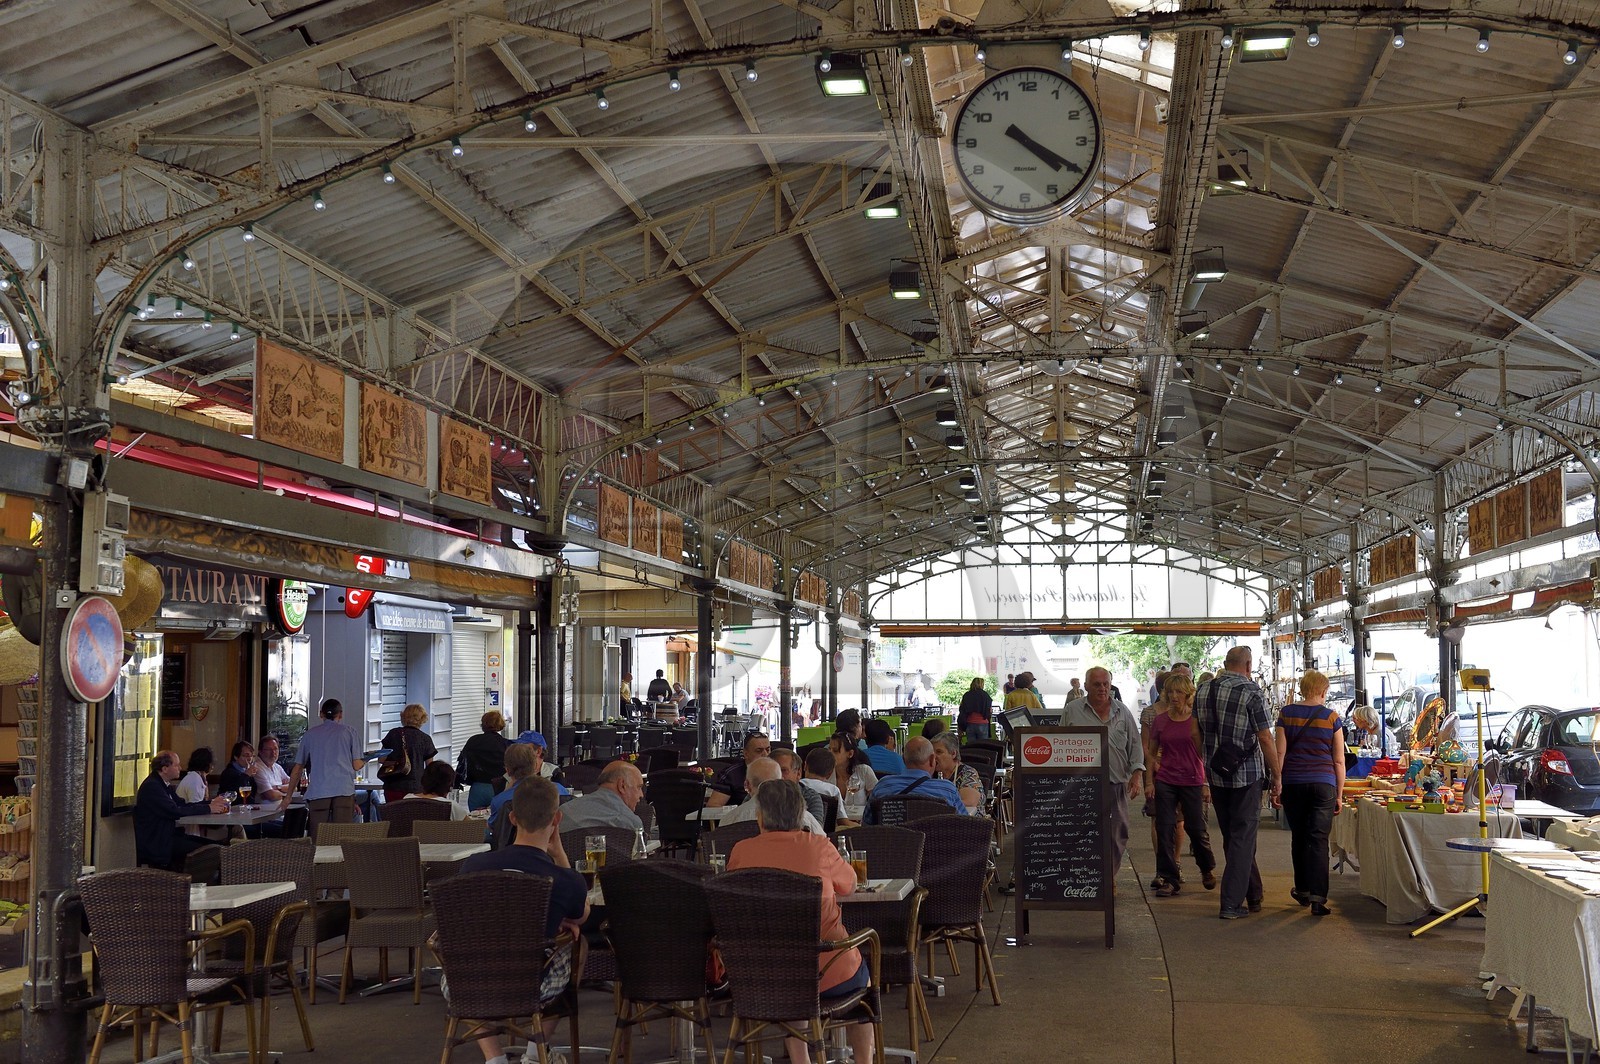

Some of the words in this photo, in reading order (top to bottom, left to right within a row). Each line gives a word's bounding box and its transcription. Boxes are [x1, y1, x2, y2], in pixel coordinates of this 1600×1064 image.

[1018, 81, 1038, 92] 12
[993, 91, 1009, 101] 11
[1051, 90, 1060, 100] 1
[972, 112, 992, 123] 10
[1068, 110, 1081, 121] 2
[965, 138, 977, 149] 9
[1075, 136, 1087, 147] 3
[972, 165, 984, 175] 8
[993, 185, 1004, 195] 7
[1046, 184, 1058, 195] 5
[1019, 193, 1031, 203] 6
[1053, 738, 1093, 747] Partagez
[1024, 745, 1051, 755] Coca-Cola
[1066, 755, 1095, 763] Plaisir
[1064, 886, 1099, 898] Coca-Cola
